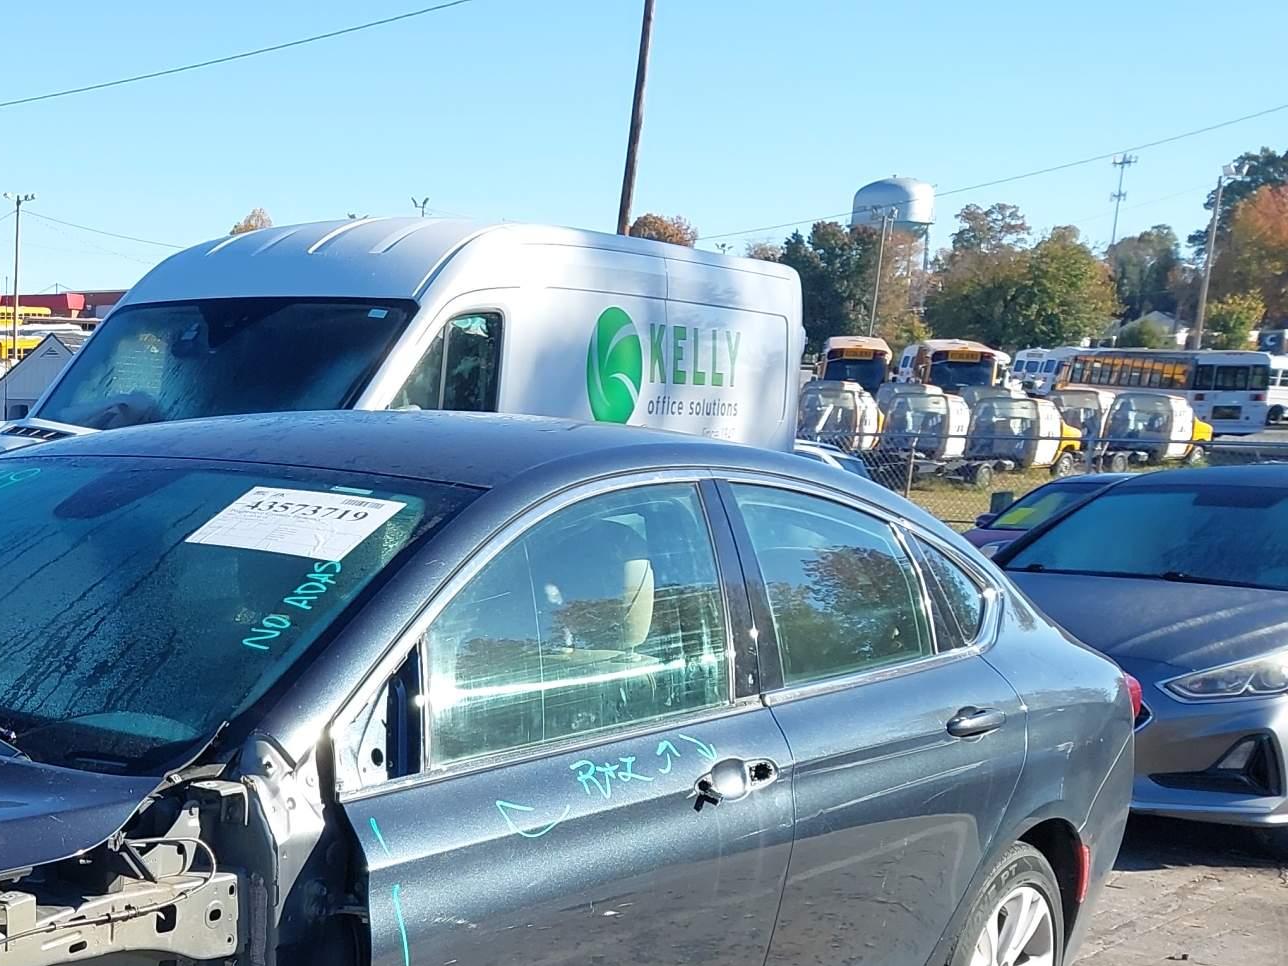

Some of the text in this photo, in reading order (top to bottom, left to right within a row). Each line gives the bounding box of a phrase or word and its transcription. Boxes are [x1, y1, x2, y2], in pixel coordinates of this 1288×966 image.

[650, 323, 741, 387] KELLY
[648, 397, 739, 417] office solutions
[247, 499, 369, 522] 43573719
[242, 560, 342, 650] NO ADAS
